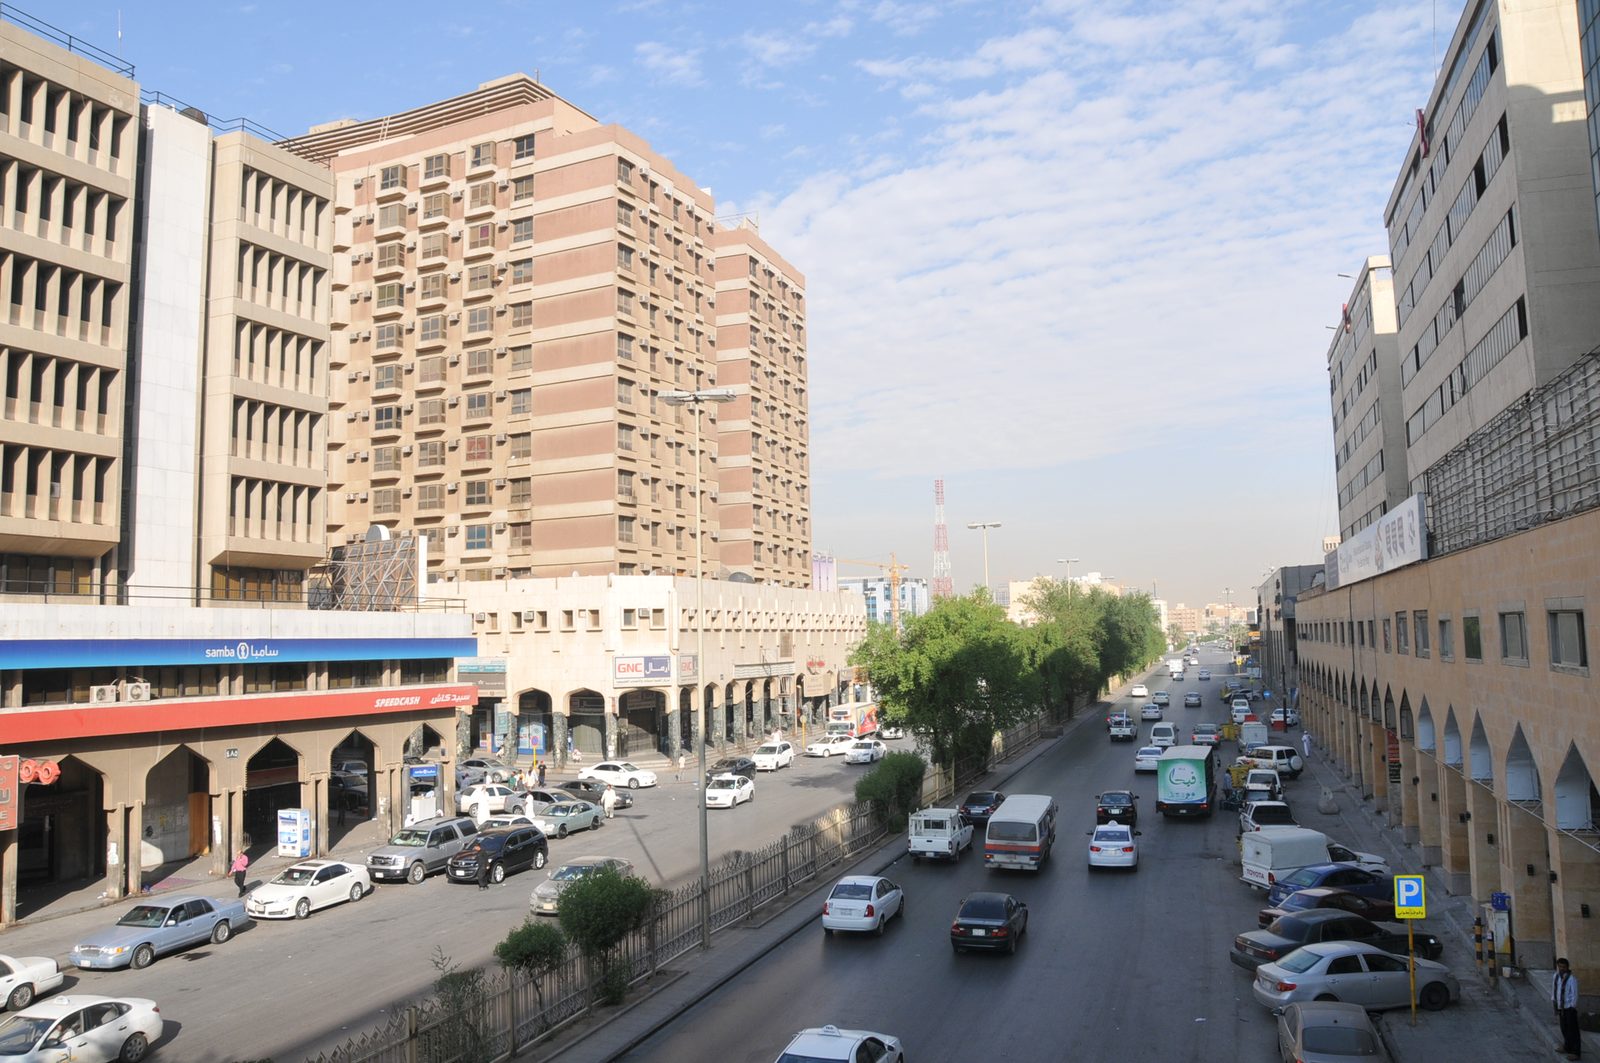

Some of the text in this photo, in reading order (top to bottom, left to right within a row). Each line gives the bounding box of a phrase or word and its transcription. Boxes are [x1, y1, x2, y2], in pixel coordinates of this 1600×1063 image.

[205, 645, 235, 658] samba
[250, 644, 279, 659] سامبا
[617, 663, 643, 673] GNC
[374, 696, 421, 708] SPEEDCASH
[1246, 868, 1265, 879] TOYOTA
[1399, 879, 1419, 905] P
